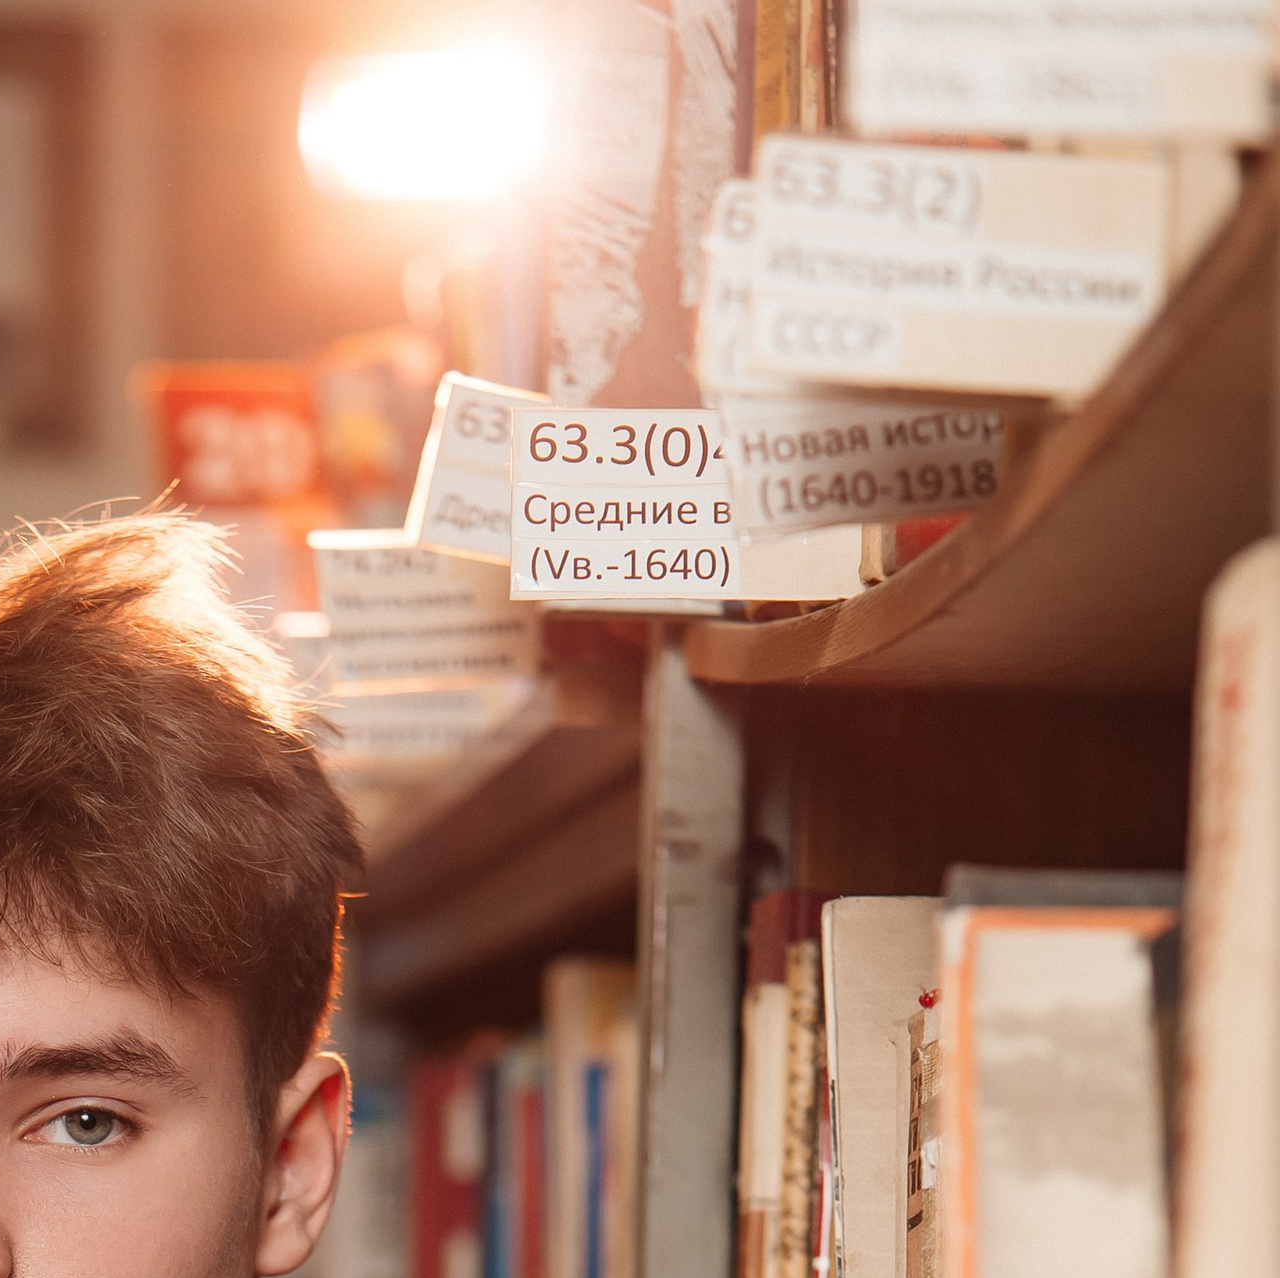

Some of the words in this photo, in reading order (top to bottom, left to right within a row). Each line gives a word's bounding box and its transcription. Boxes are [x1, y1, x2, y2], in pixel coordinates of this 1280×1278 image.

[741, 424, 870, 464] Новая
[882, 411, 1005, 447] истор
[523, 493, 698, 532] Средние
[760, 458, 998, 522] (1640-1918
